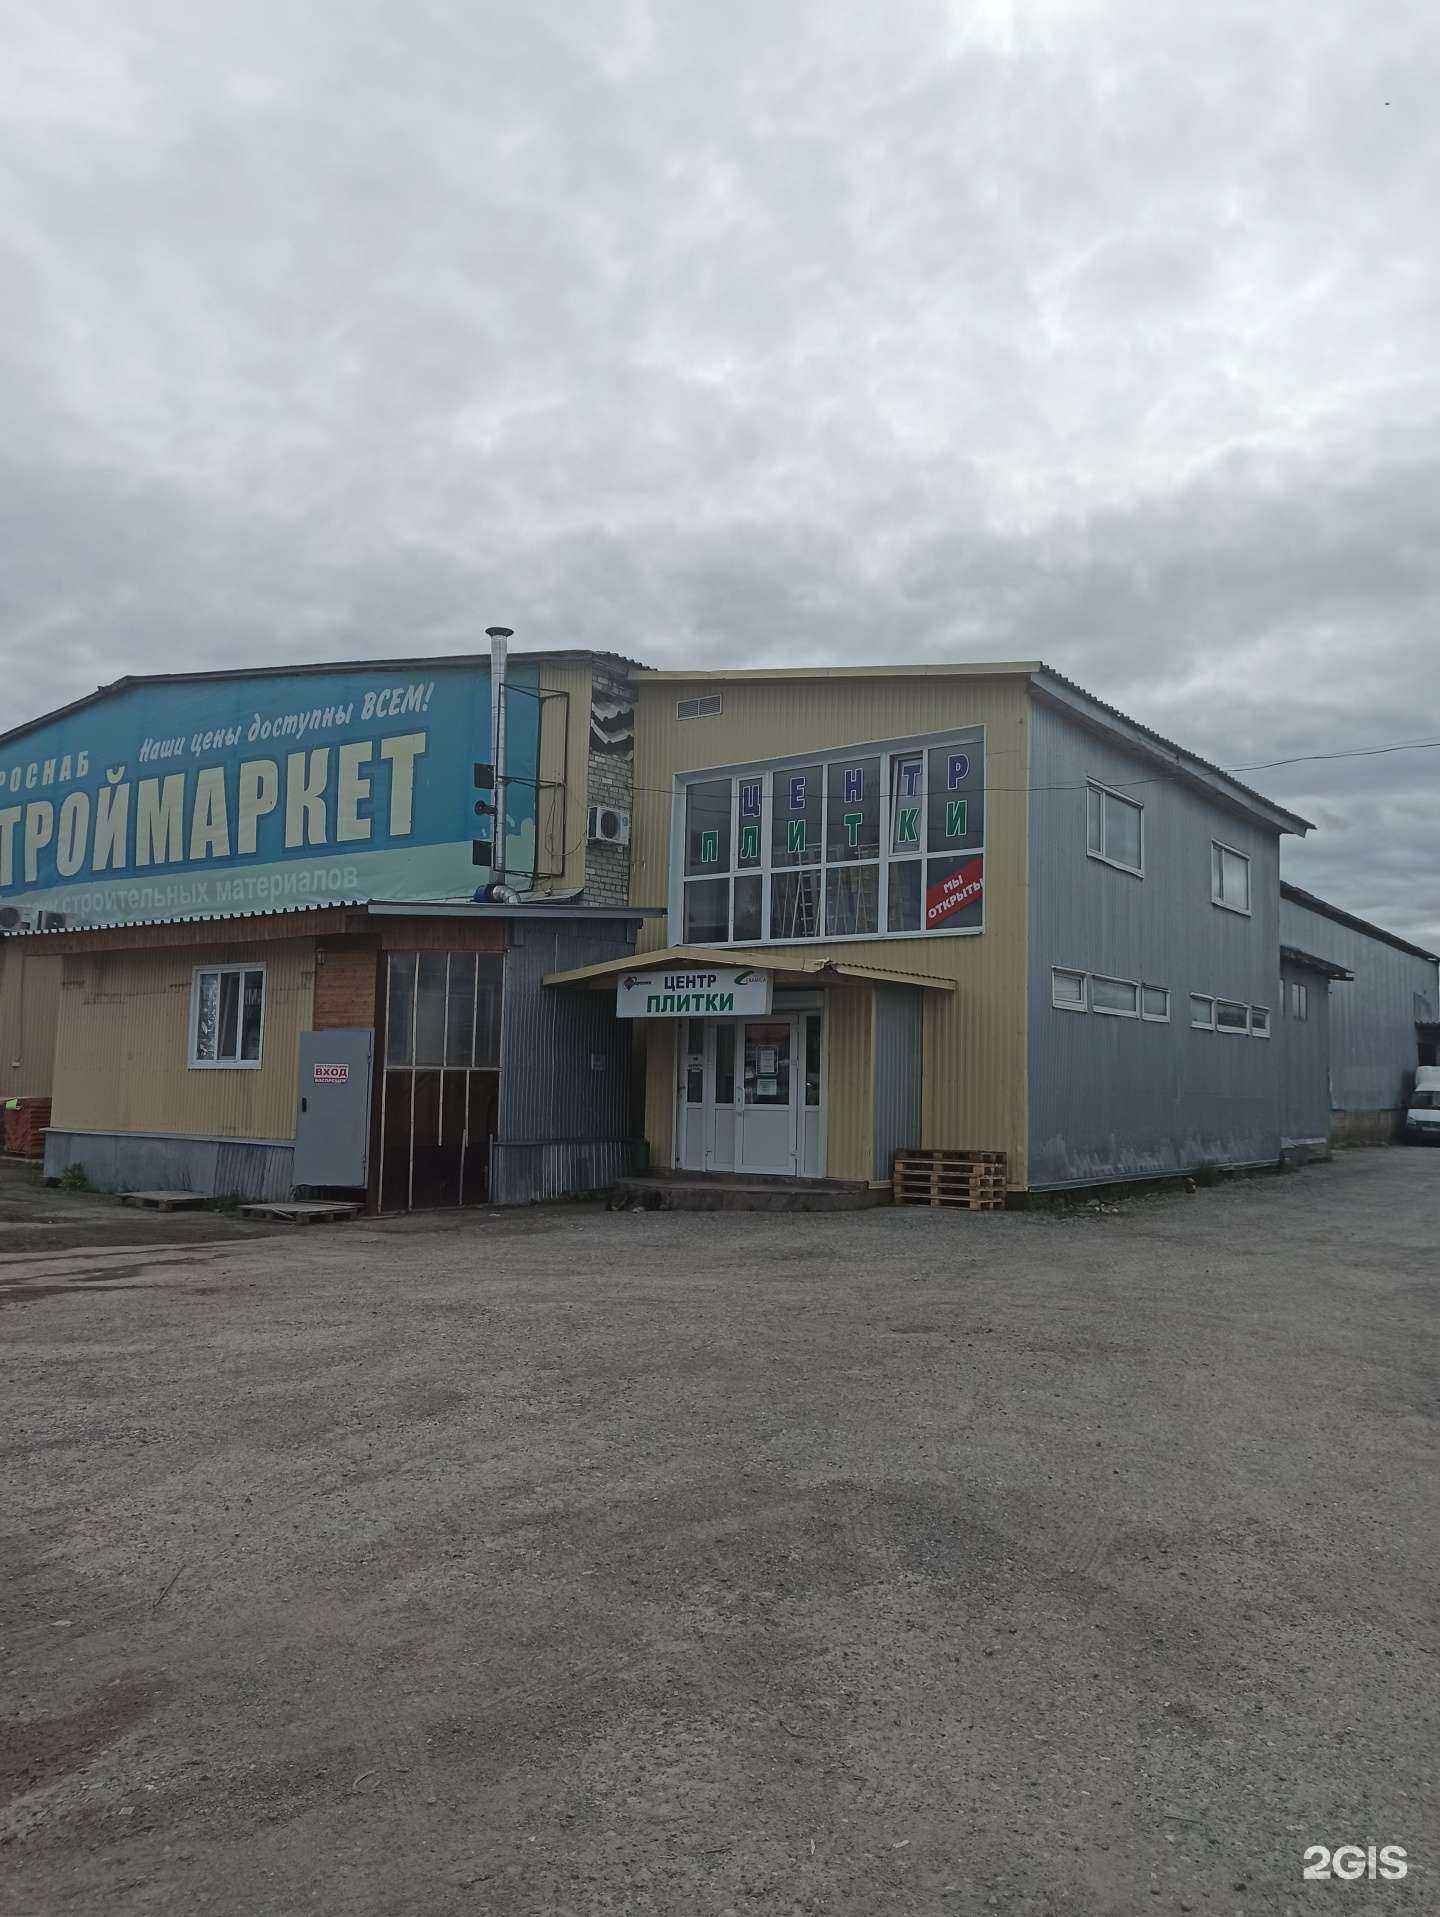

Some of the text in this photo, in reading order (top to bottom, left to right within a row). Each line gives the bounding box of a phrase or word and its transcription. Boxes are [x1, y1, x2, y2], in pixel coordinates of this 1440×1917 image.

[139, 682, 434, 762] Наши цены доступны ВСЕМ!
[741, 753, 970, 818] ЦЕНТР
[0, 732, 427, 887] ТРОЙМАРКЕТ
[701, 799, 968, 863] ПЛИТКИ
[216, 866, 359, 903] материалов
[943, 874, 963, 894] МЫ
[664, 974, 716, 991] ЦЕНТР
[646, 992, 734, 1013] ПЛИТКИ
[315, 1068, 348, 1078] ВХОД
